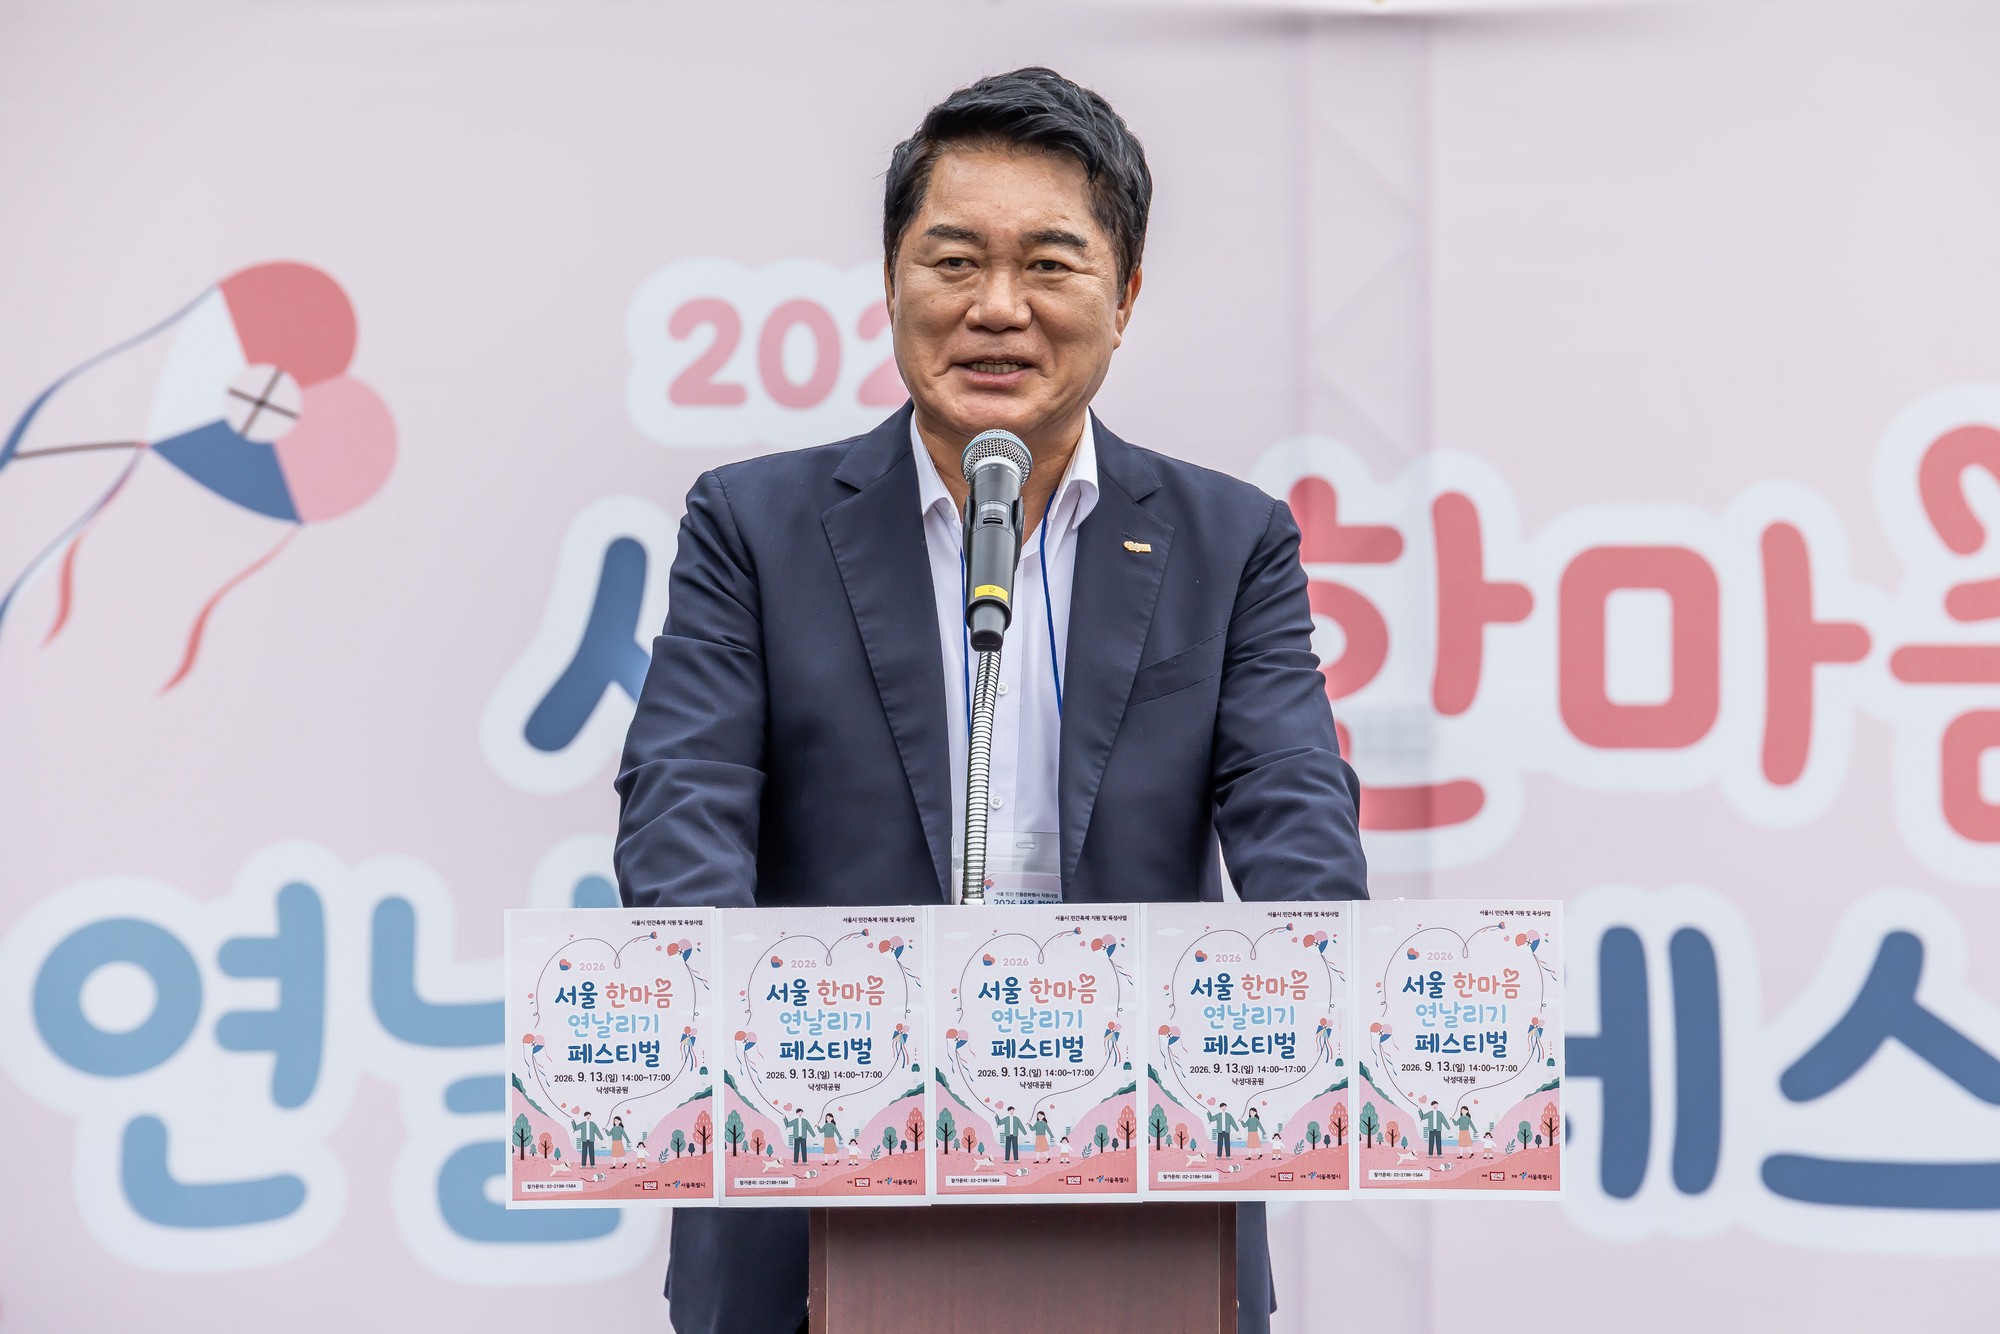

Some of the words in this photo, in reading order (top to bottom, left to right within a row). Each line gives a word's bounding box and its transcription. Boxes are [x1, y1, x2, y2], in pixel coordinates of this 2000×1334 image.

[667, 297, 911, 410] 202
[579, 963, 605, 971] 2026
[791, 960, 817, 968] 2026
[1003, 958, 1029, 966] 2026
[1215, 954, 1241, 963] 2026
[1427, 952, 1453, 960] 2026
[555, 982, 598, 1009] 서울
[605, 978, 673, 1008] 한마음
[766, 979, 810, 1006] 서울
[817, 975, 885, 1006] 한마음
[978, 977, 1022, 1004] 서울
[1029, 973, 1097, 1004] 한마음
[1190, 973, 1234, 1001] 서울
[1241, 970, 1309, 1000] 한마음
[1402, 971, 1446, 998] 서울
[1453, 968, 1521, 999] 한마음
[568, 1012, 659, 1038] 연날리기
[780, 1009, 871, 1035] 연날리기
[991, 1007, 1083, 1033] 연날리기
[1204, 1003, 1295, 1030] 연날리기
[1415, 1002, 1506, 1028] 연날리기
[567, 1040, 660, 1067] 페스티벌
[779, 1037, 872, 1064] 페스티벌
[991, 1035, 1083, 1062] 페스티벌
[1203, 1032, 1295, 1059] 페스티벌
[1415, 1030, 1507, 1057] 페스티벌
[554, 1074, 574, 1082] 2026.
[577, 1071, 586, 1082] 9.
[590, 1071, 617, 1082] 13.(일)
[766, 1071, 786, 1079] 2026.
[789, 1068, 798, 1078] 9.
[802, 1068, 829, 1079] 13.(일)
[977, 1069, 998, 1077] 2026.
[1001, 1066, 1010, 1076] 9.
[1013, 1066, 1041, 1077] 13.(일)
[1213, 1063, 1222, 1073] 9.
[1225, 1063, 1253, 1074] 13.(일)
[1257, 1065, 1306, 1073] 14:00~17:00
[1401, 1063, 1422, 1071] 2026.
[1424, 1061, 1433, 1071] 9.
[1437, 1061, 1465, 1072] 13.(일)
[1469, 1064, 1517, 1072] 14:00~17:00
[596, 1086, 628, 1094] 낙성대공원
[808, 1083, 840, 1091] 낙성대공원
[1019, 1081, 1052, 1089] 낙성대공원
[1232, 1077, 1264, 1085] 낙성대공원
[1443, 1076, 1475, 1084] 낙성대공원
